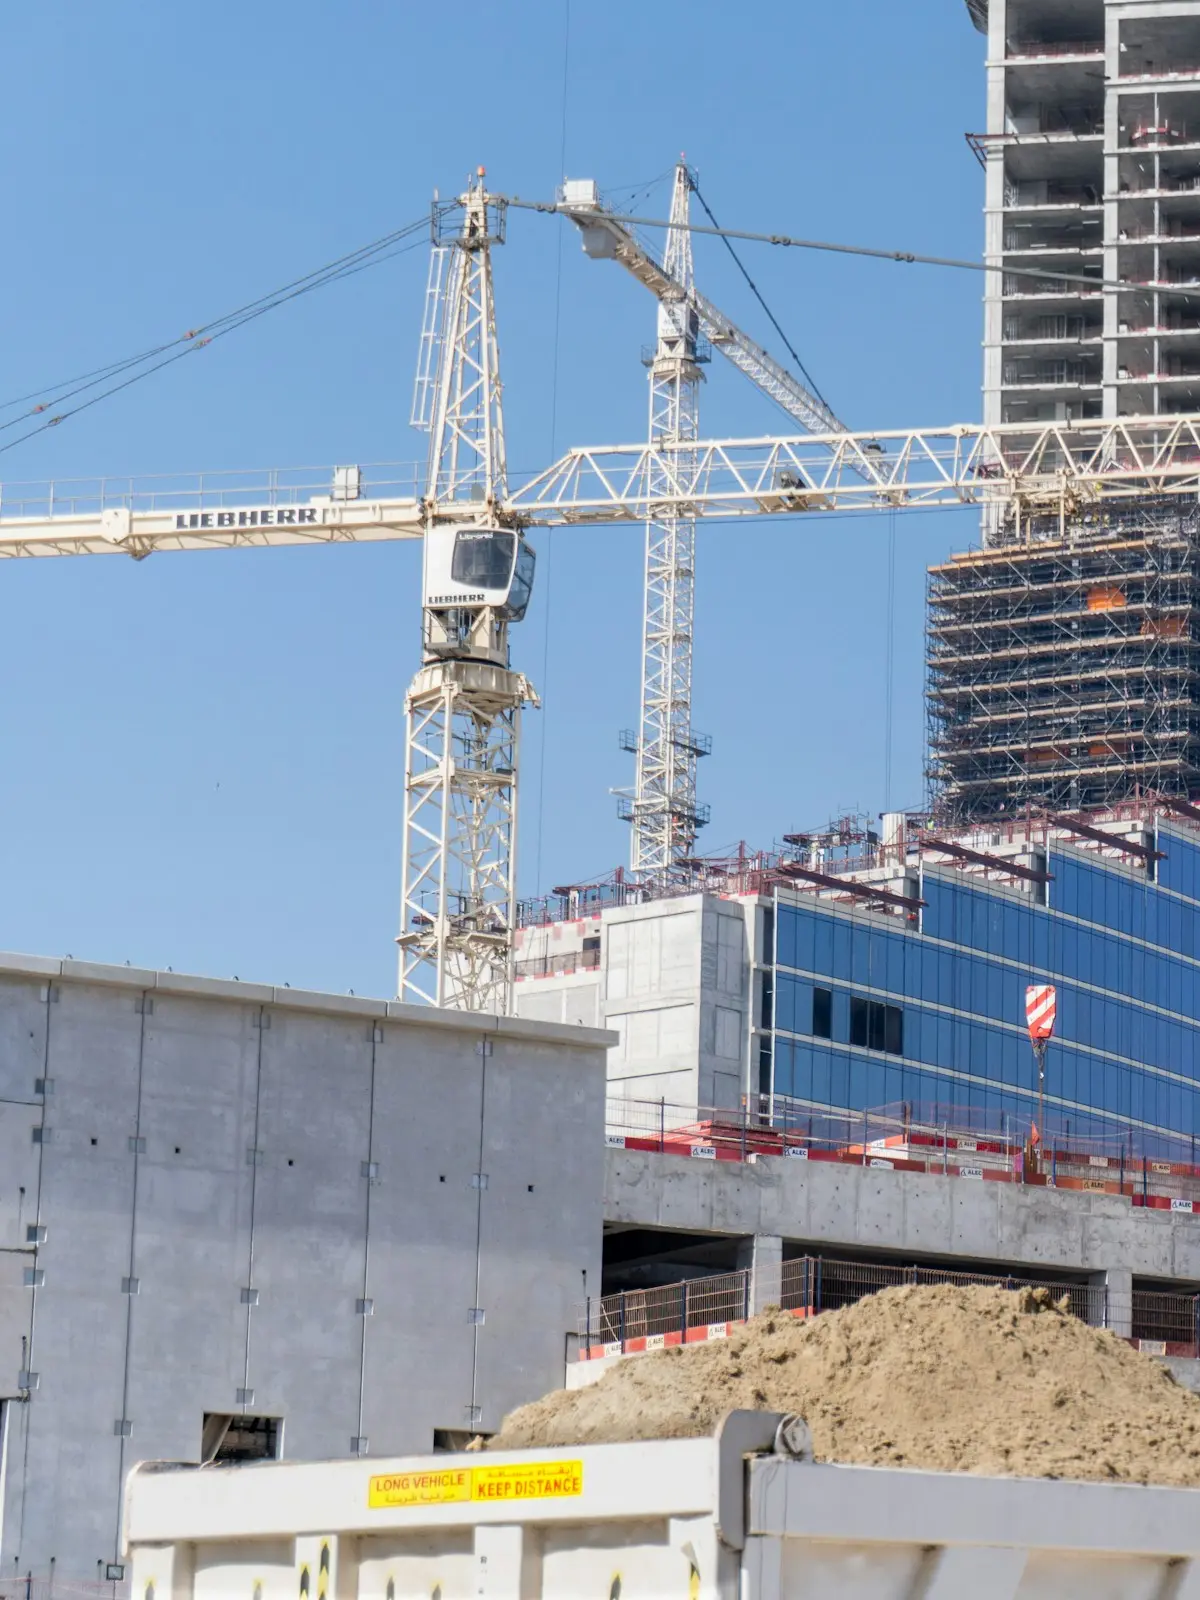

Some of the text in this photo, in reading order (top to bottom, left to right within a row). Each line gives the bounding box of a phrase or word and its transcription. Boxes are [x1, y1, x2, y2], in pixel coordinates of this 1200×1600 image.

[176, 507, 317, 529] LIEBHERR
[428, 593, 486, 605] LIEBHERR
[609, 1137, 625, 1145] ALEC
[700, 1148, 715, 1156] ALEC
[791, 1149, 808, 1157] ALEC
[1091, 1181, 1105, 1189] ALEC
[376, 1473, 465, 1492] LONG VEHICLE
[477, 1476, 580, 1497] KEEP DISTANCE
